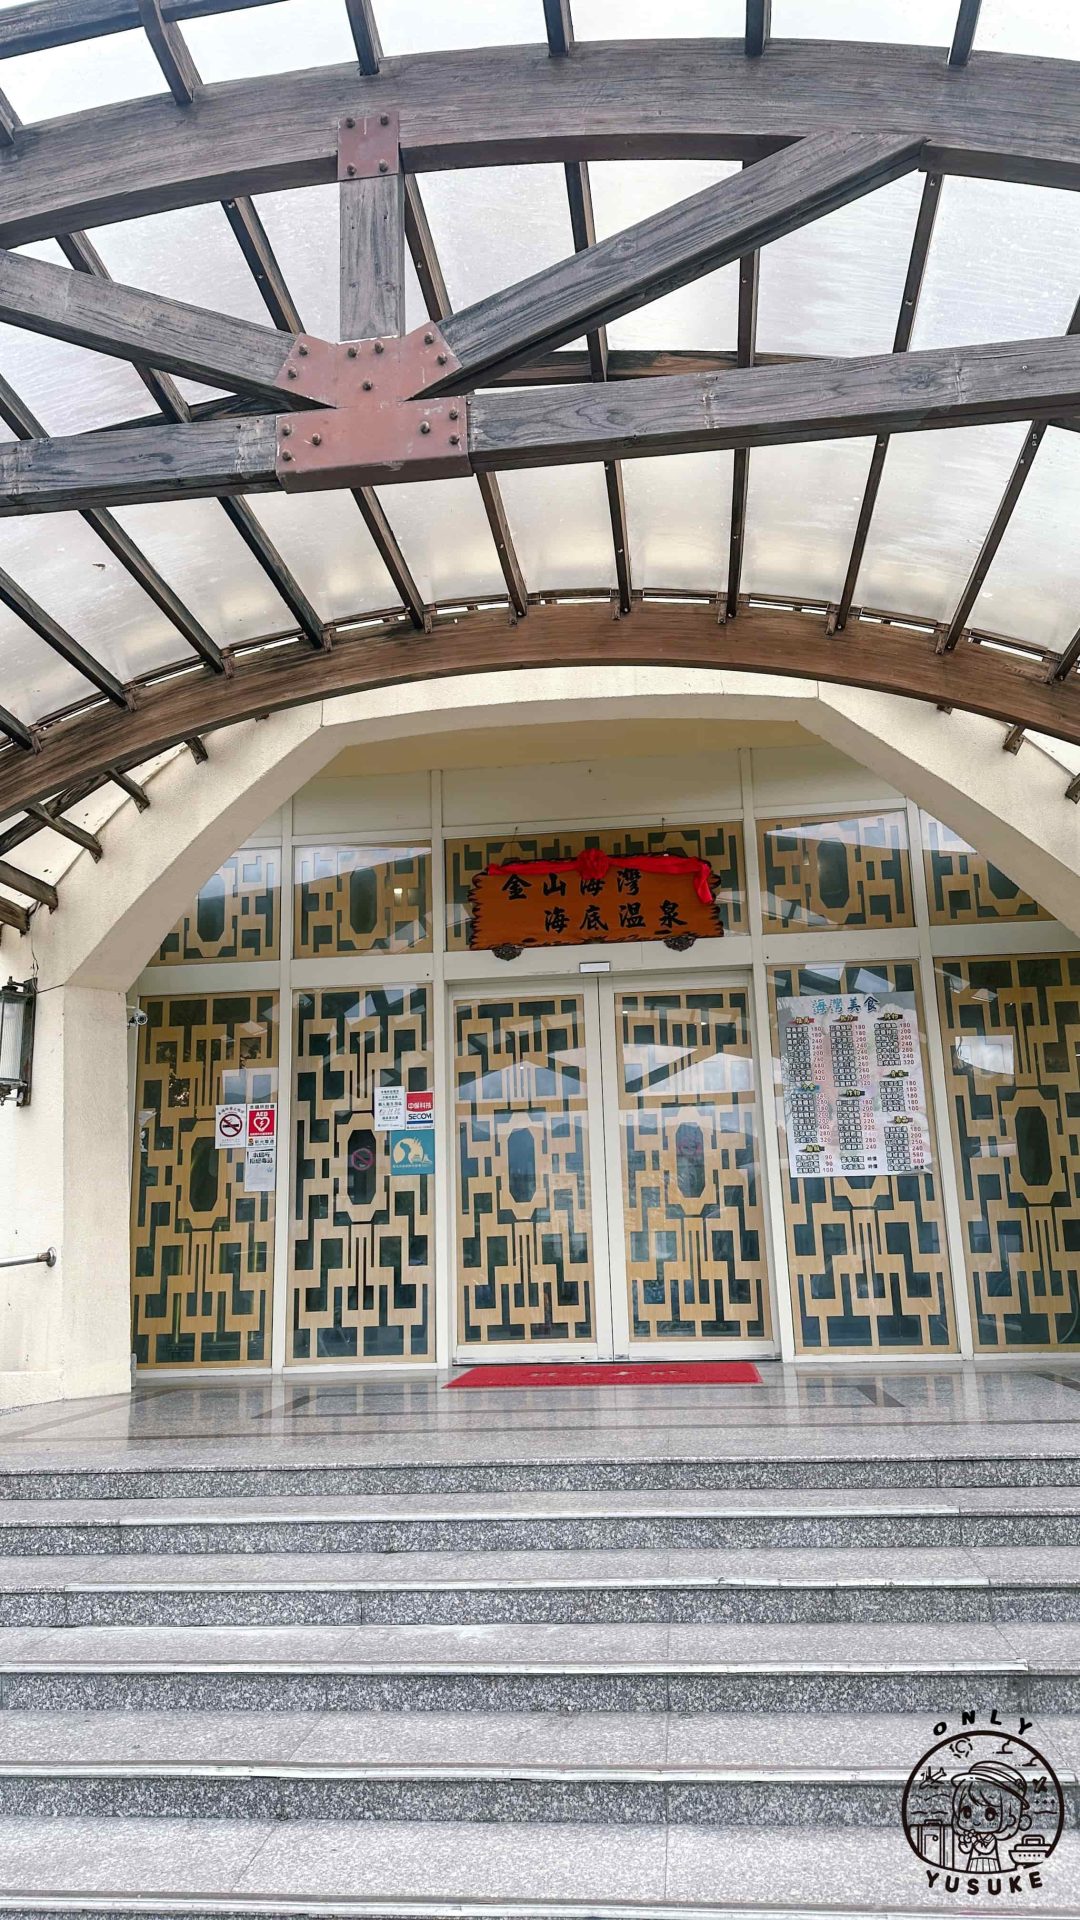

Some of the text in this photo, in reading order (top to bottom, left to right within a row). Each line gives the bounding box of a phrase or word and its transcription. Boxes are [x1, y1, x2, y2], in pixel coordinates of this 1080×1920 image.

[502, 868, 642, 900] 金山海灣
[812, 996, 878, 1013] 海灣美食
